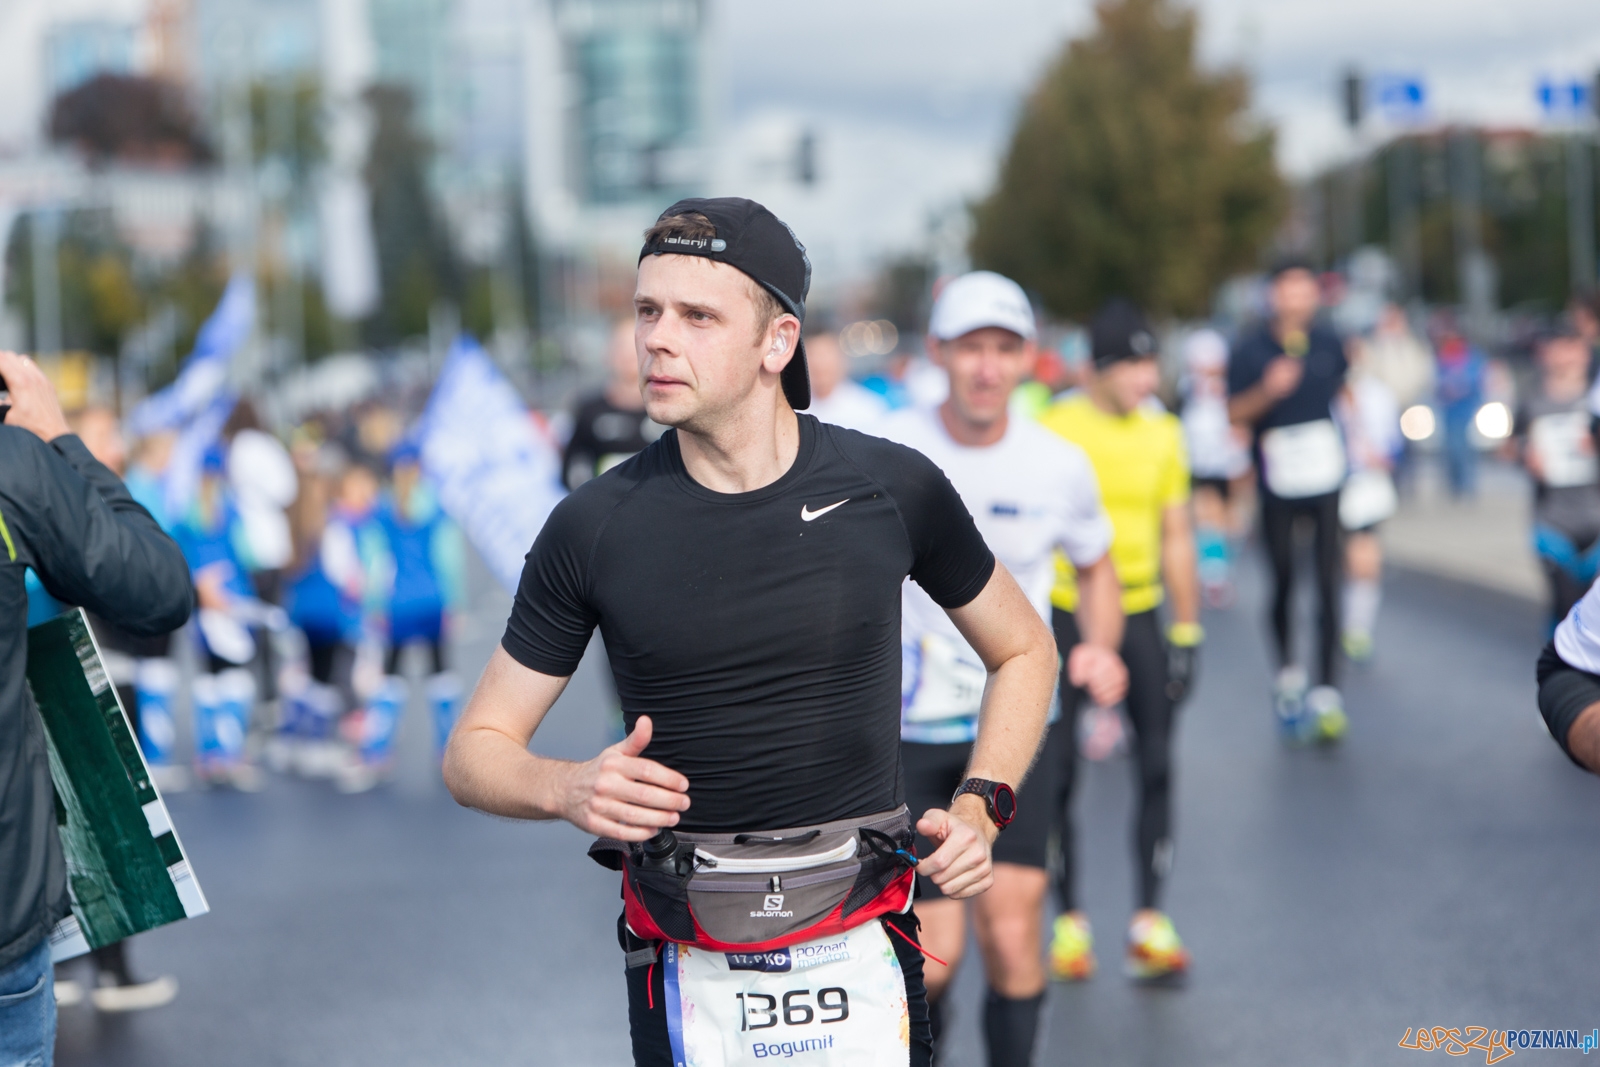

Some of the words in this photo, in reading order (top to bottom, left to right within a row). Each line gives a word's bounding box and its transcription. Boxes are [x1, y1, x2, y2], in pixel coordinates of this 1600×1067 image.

[797, 950, 851, 968] maraton
[735, 986, 849, 1032] 1369
[752, 1034, 835, 1058] Bogumił
